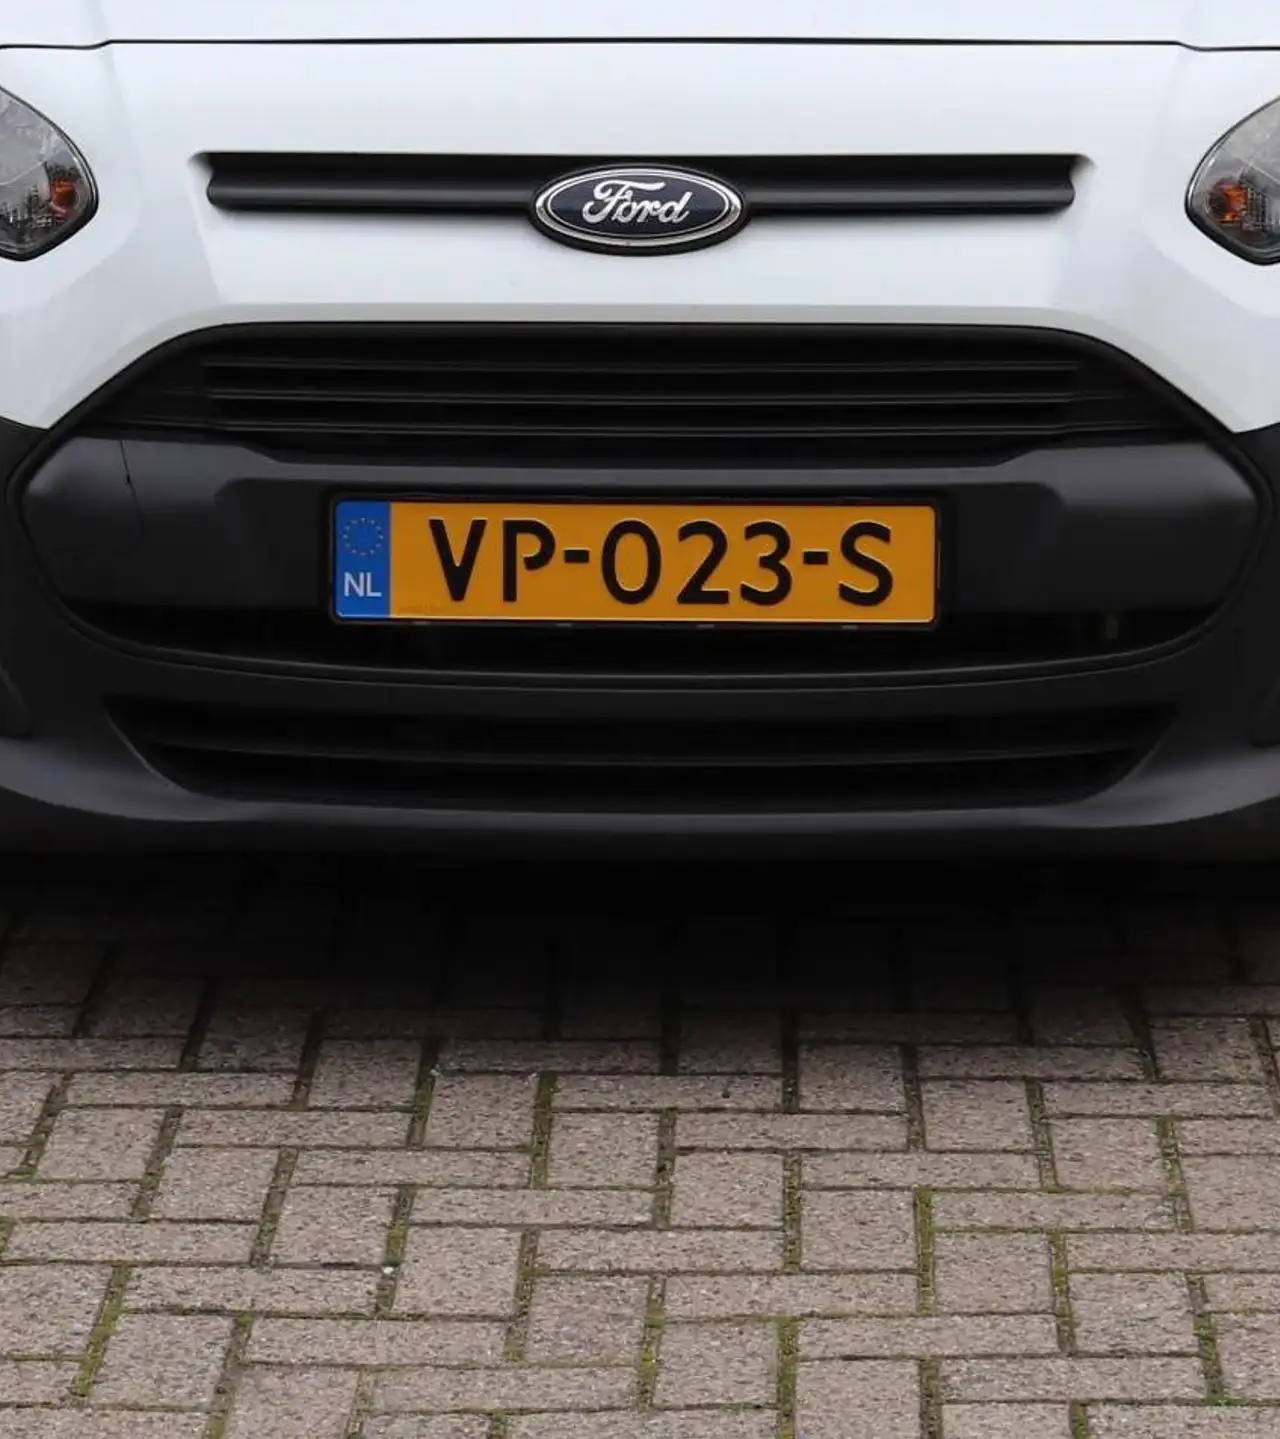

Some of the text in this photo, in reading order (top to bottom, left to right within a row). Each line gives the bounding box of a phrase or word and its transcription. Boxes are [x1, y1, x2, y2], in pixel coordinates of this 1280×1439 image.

[582, 179, 693, 224] Ford
[343, 571, 382, 598] NL
[428, 517, 894, 607] VP-023-S
